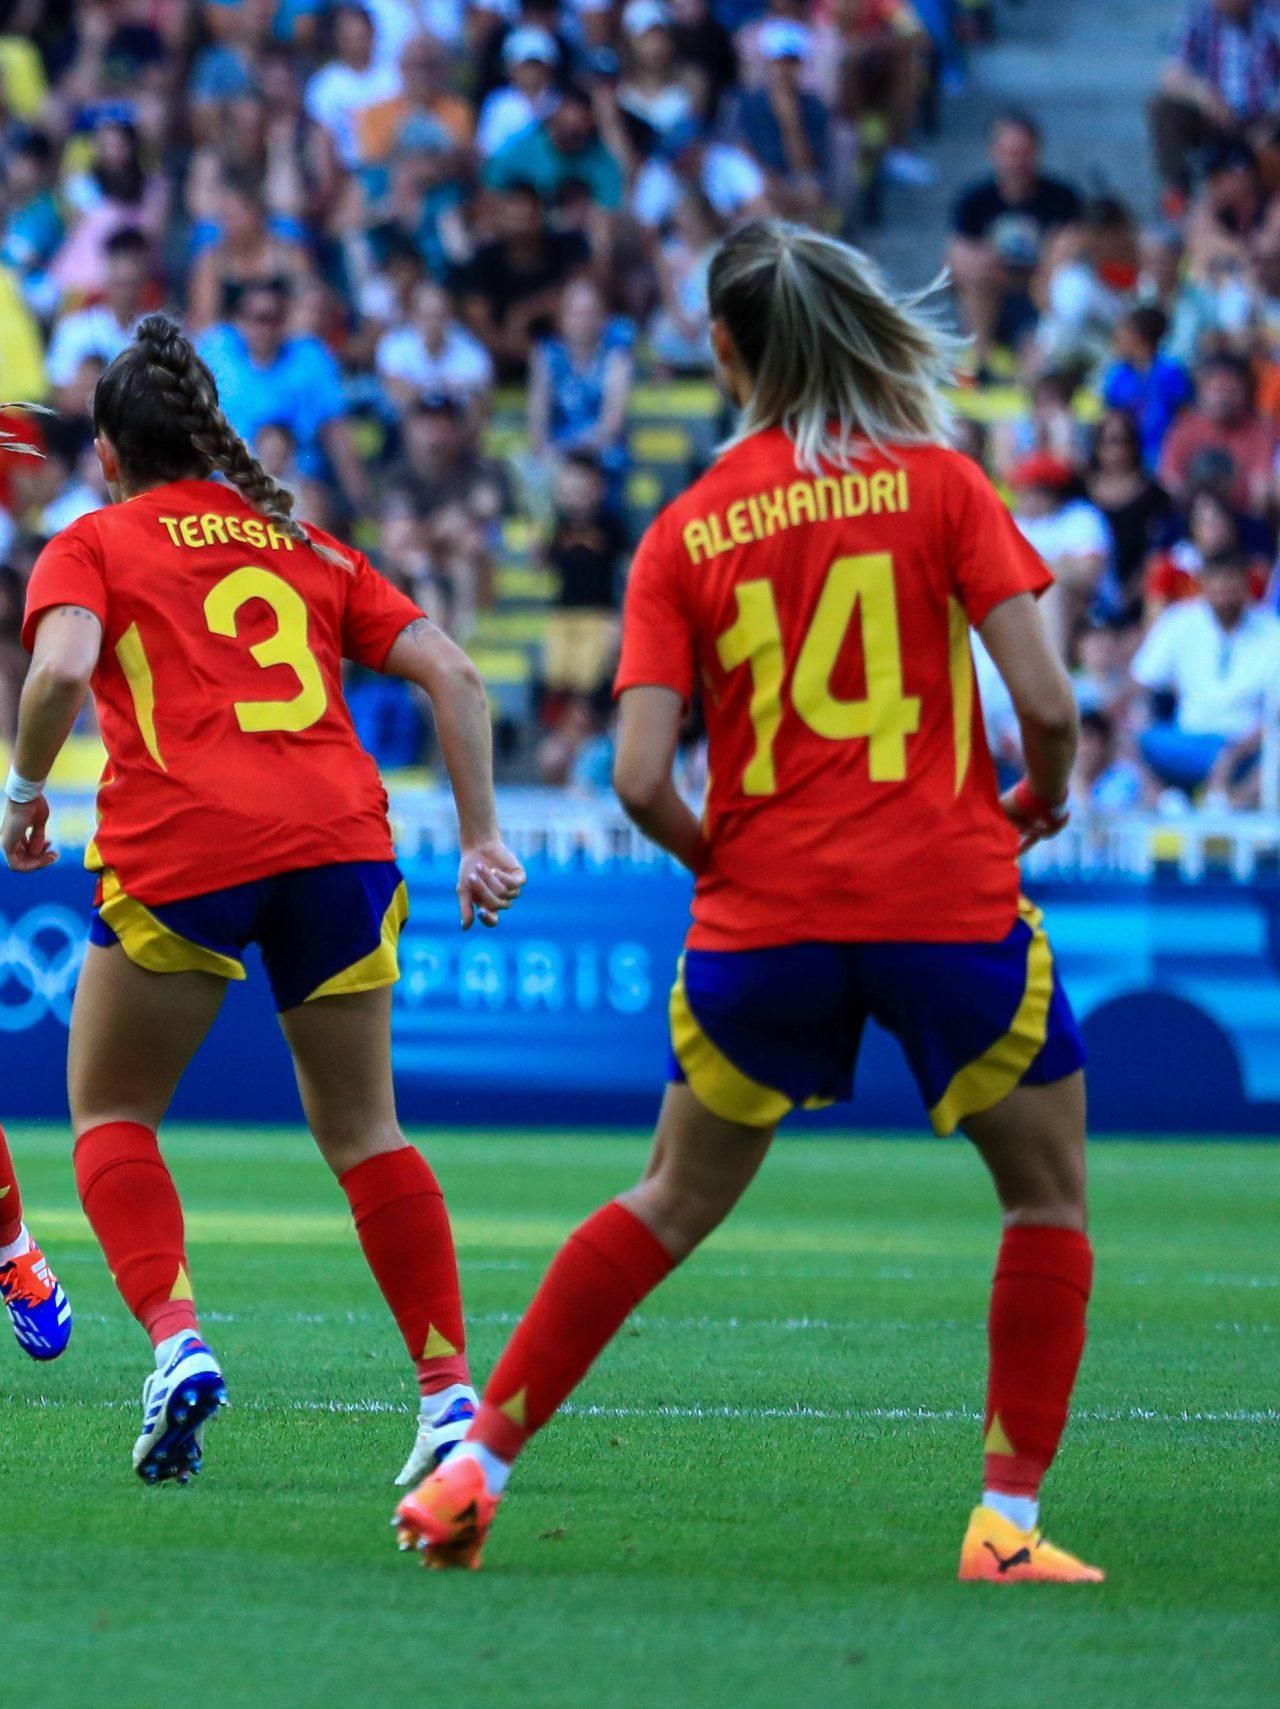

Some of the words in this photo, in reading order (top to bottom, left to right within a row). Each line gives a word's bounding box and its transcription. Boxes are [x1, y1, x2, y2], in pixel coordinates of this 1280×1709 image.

[682, 468, 909, 565] ALEIXANDRI
[204, 566, 327, 732] 3
[716, 553, 920, 796] 14
[401, 938, 651, 1014] PARIS
